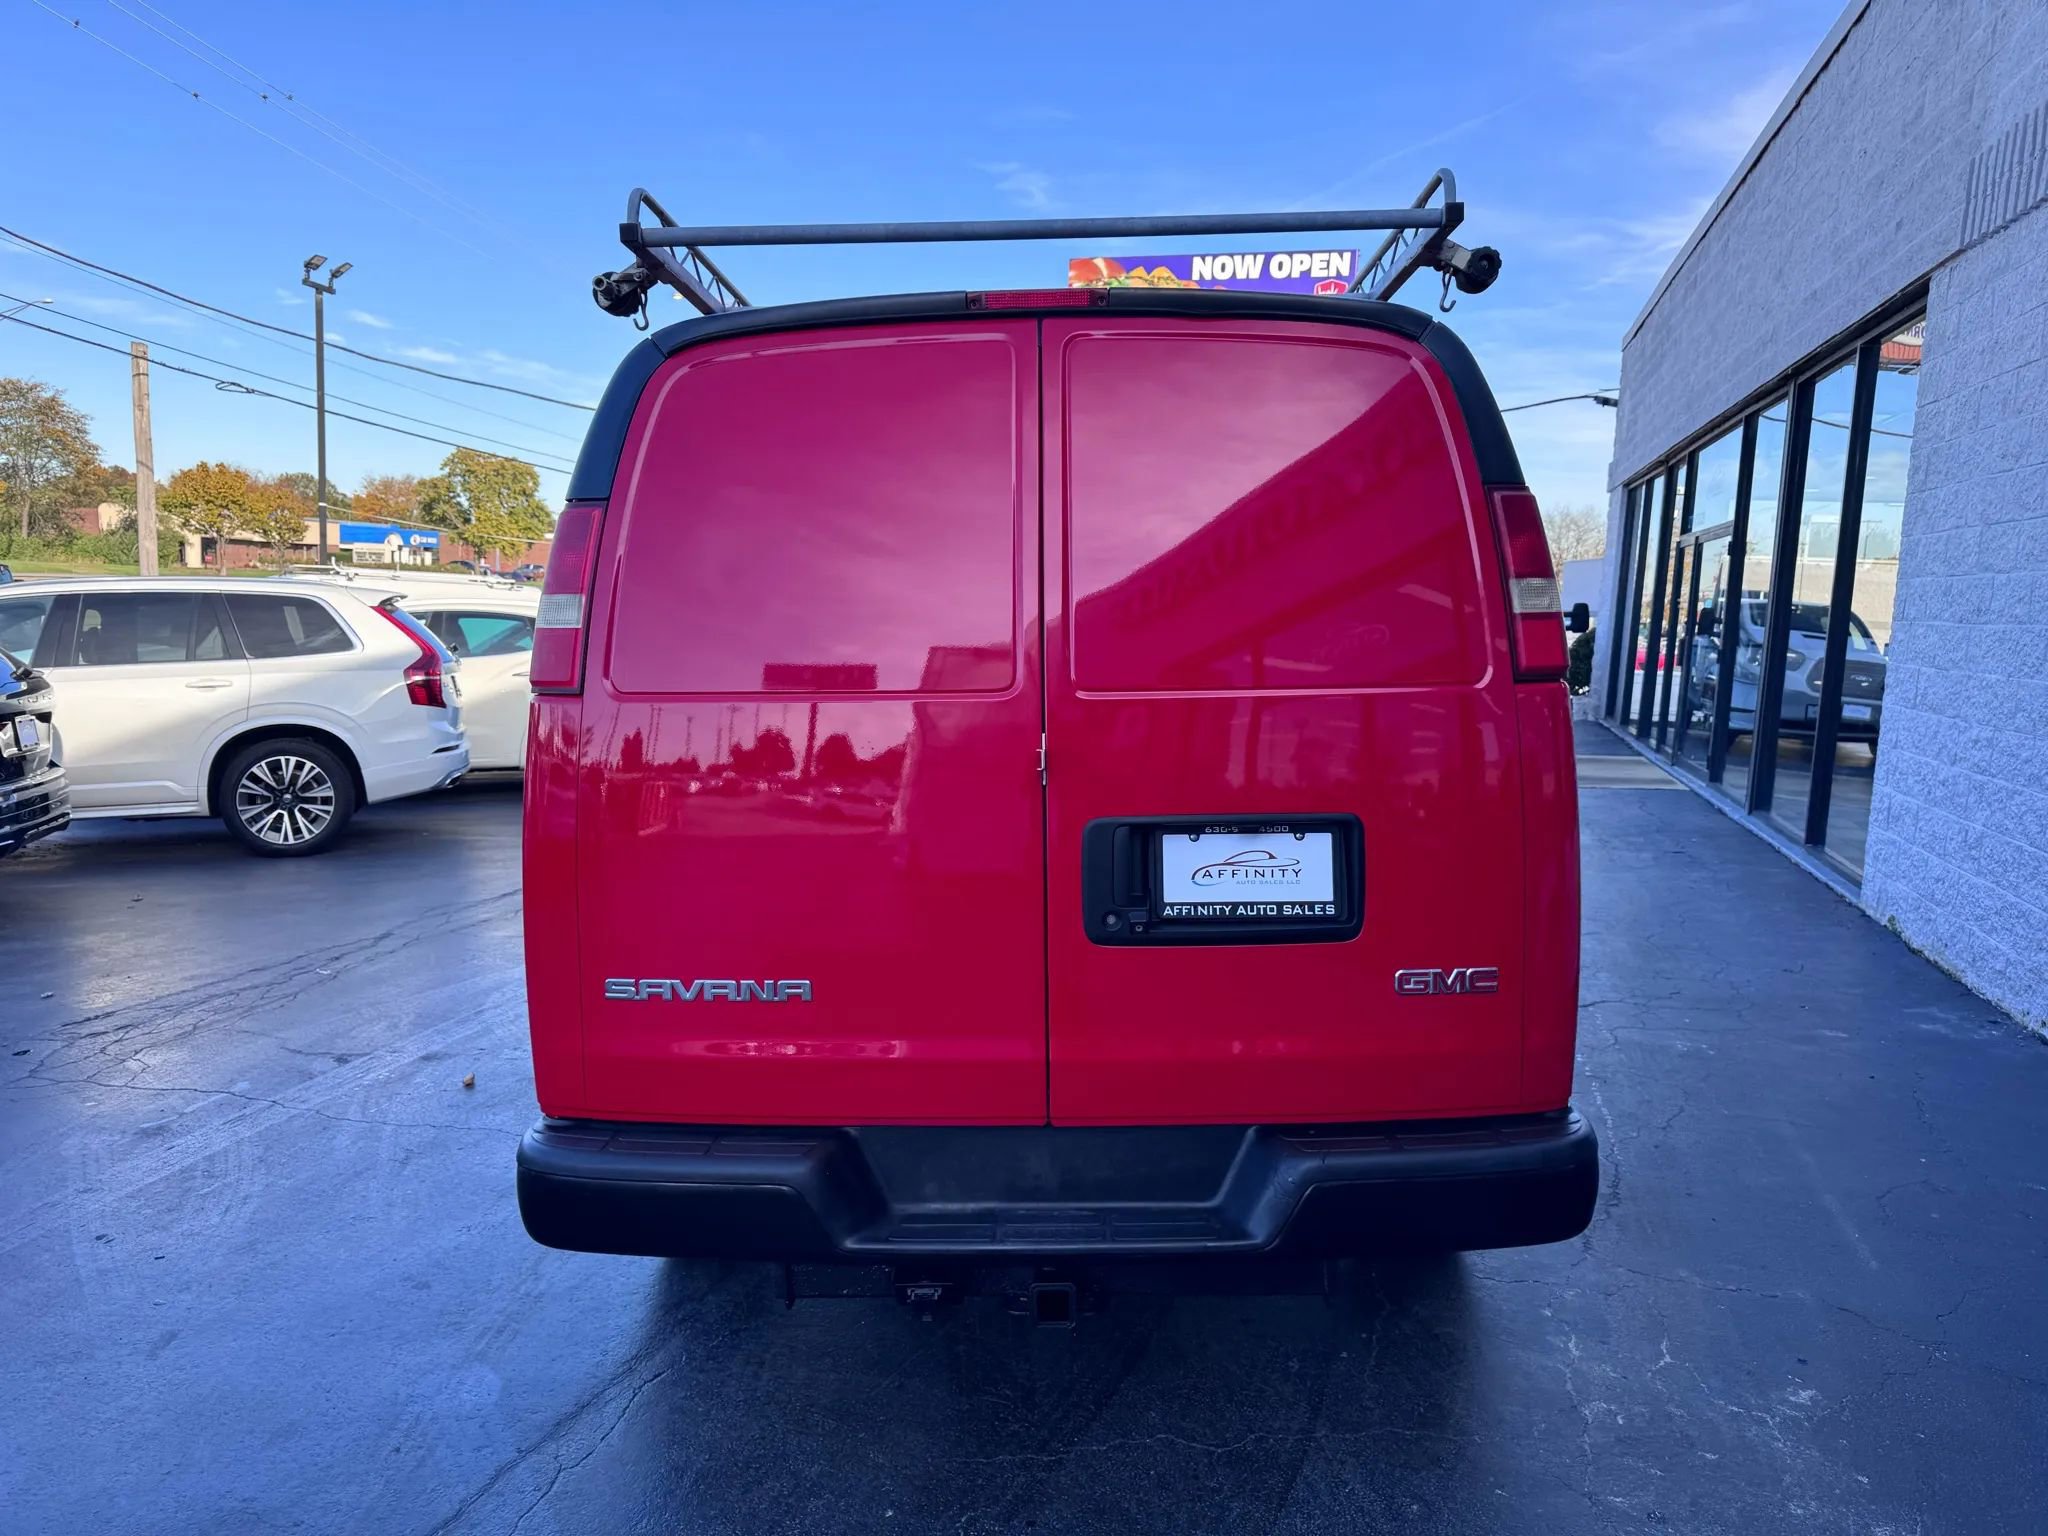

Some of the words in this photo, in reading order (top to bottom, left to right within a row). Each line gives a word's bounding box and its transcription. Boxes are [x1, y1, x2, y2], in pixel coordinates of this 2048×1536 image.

[1192, 254, 1264, 281] NOW
[1269, 251, 1351, 279] OPEN
[1201, 868, 1302, 879] AFFINITY
[1163, 905, 1233, 916] AFFINITY
[1236, 904, 1277, 916] AUTO
[1282, 904, 1336, 915] SALES
[604, 978, 812, 1002] SAVANA
[1394, 967, 1499, 994] GMC
